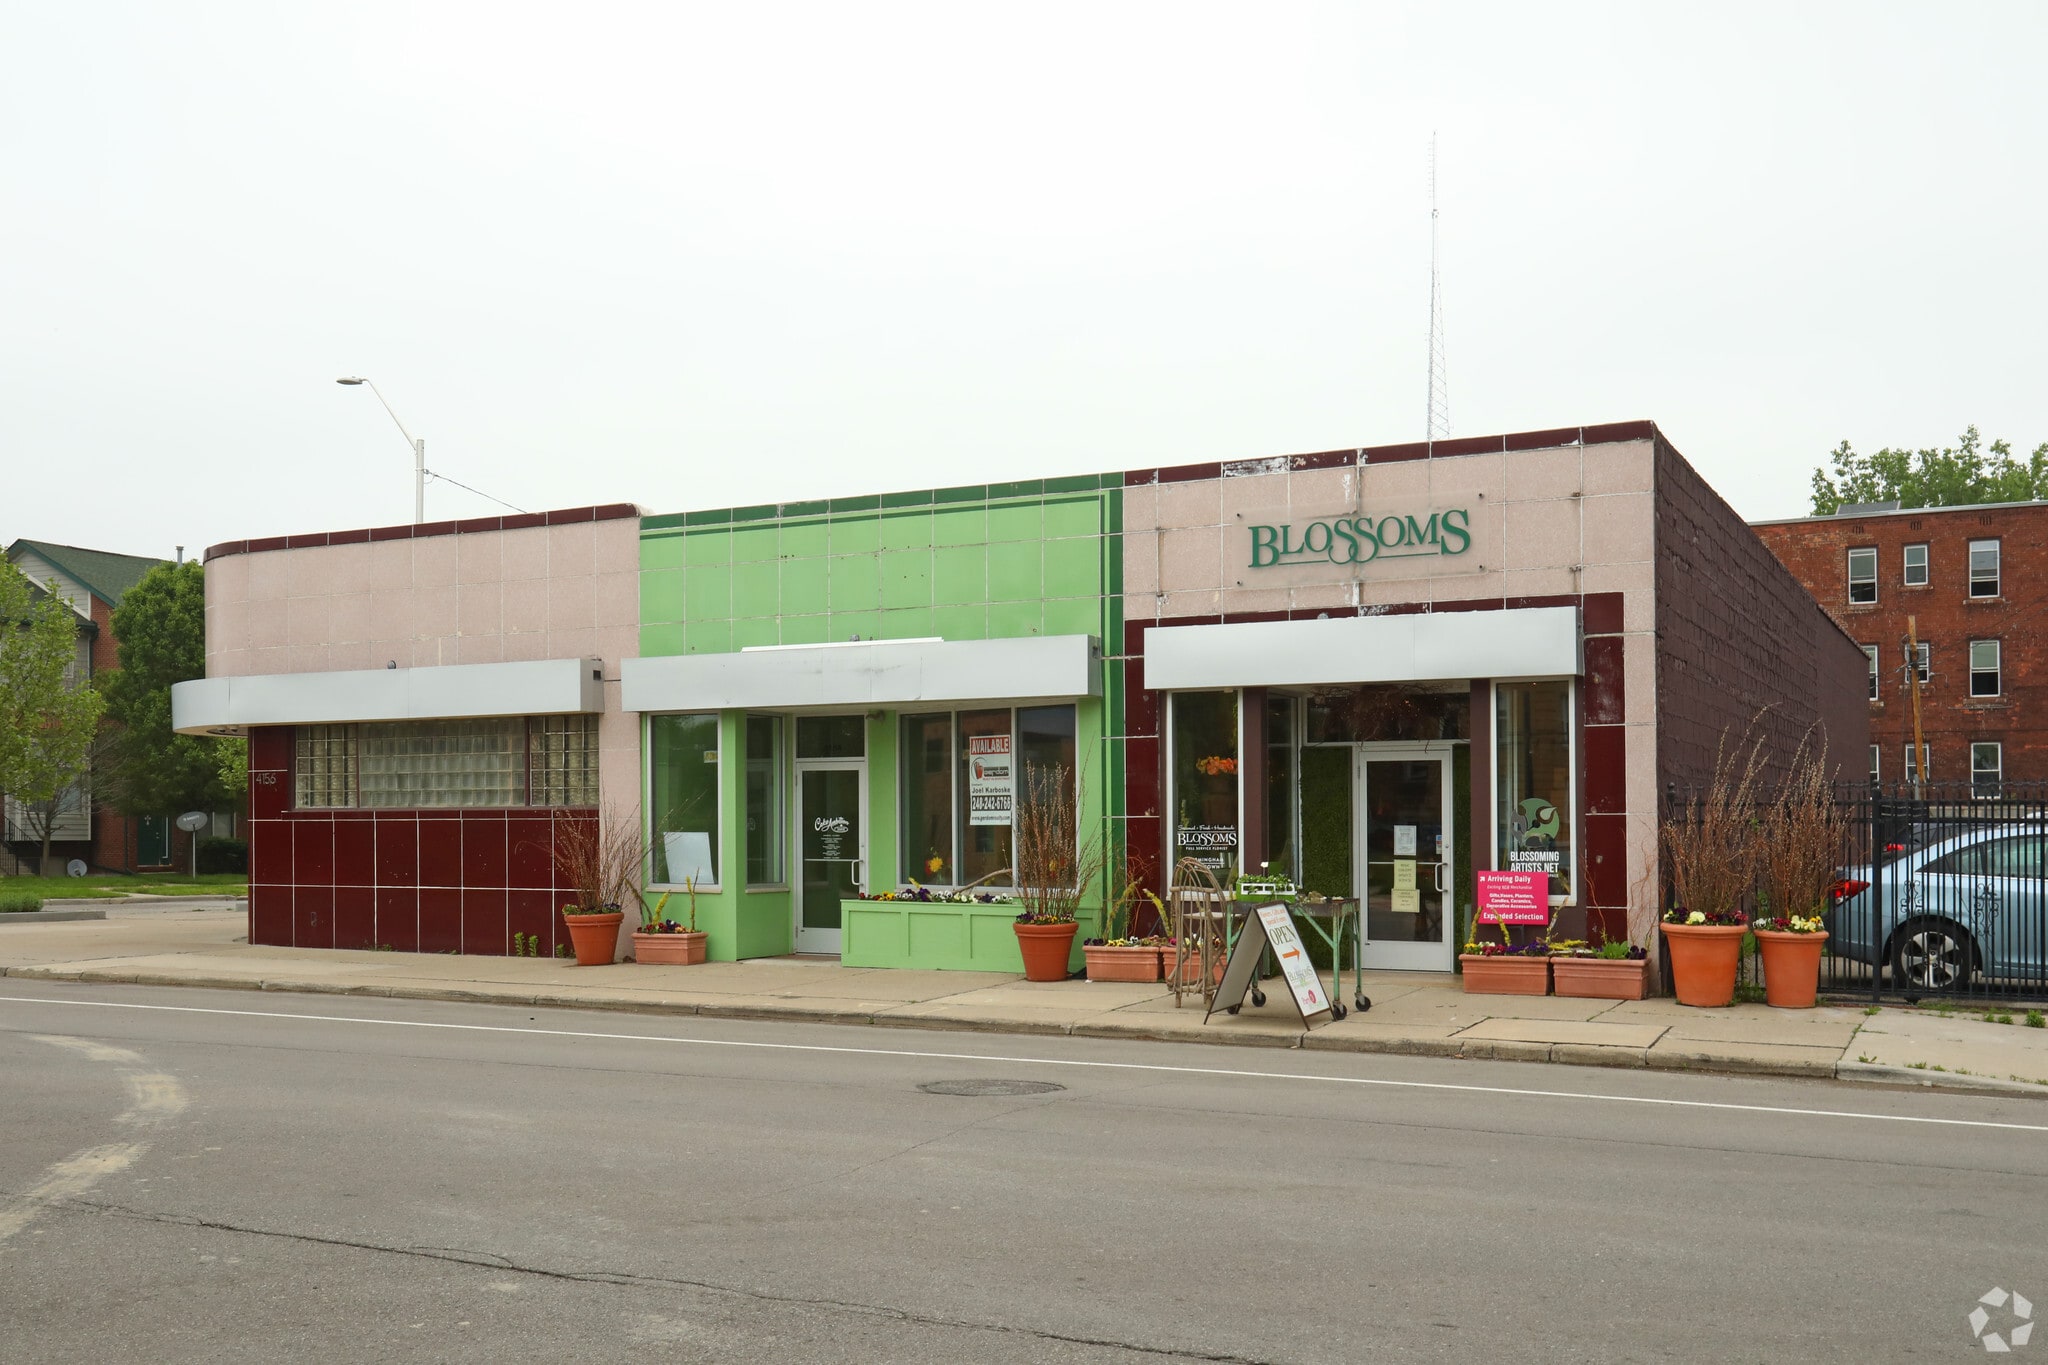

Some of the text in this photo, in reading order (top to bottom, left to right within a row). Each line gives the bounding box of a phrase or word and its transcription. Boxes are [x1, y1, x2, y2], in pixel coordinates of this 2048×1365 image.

[1248, 509, 1471, 568] BLOSSOMS
[972, 738, 1009, 753] AVAILABLE
[256, 773, 276, 784] 4156
[1177, 832, 1237, 846] BLOSSOMS
[1510, 851, 1560, 861] BLOSSOMING
[1510, 862, 1560, 873] ARTISTS.NET
[1488, 875, 1531, 885] Arriving Daily
[1483, 912, 1513, 920] Expded
[1269, 925, 1297, 946] OPEN
